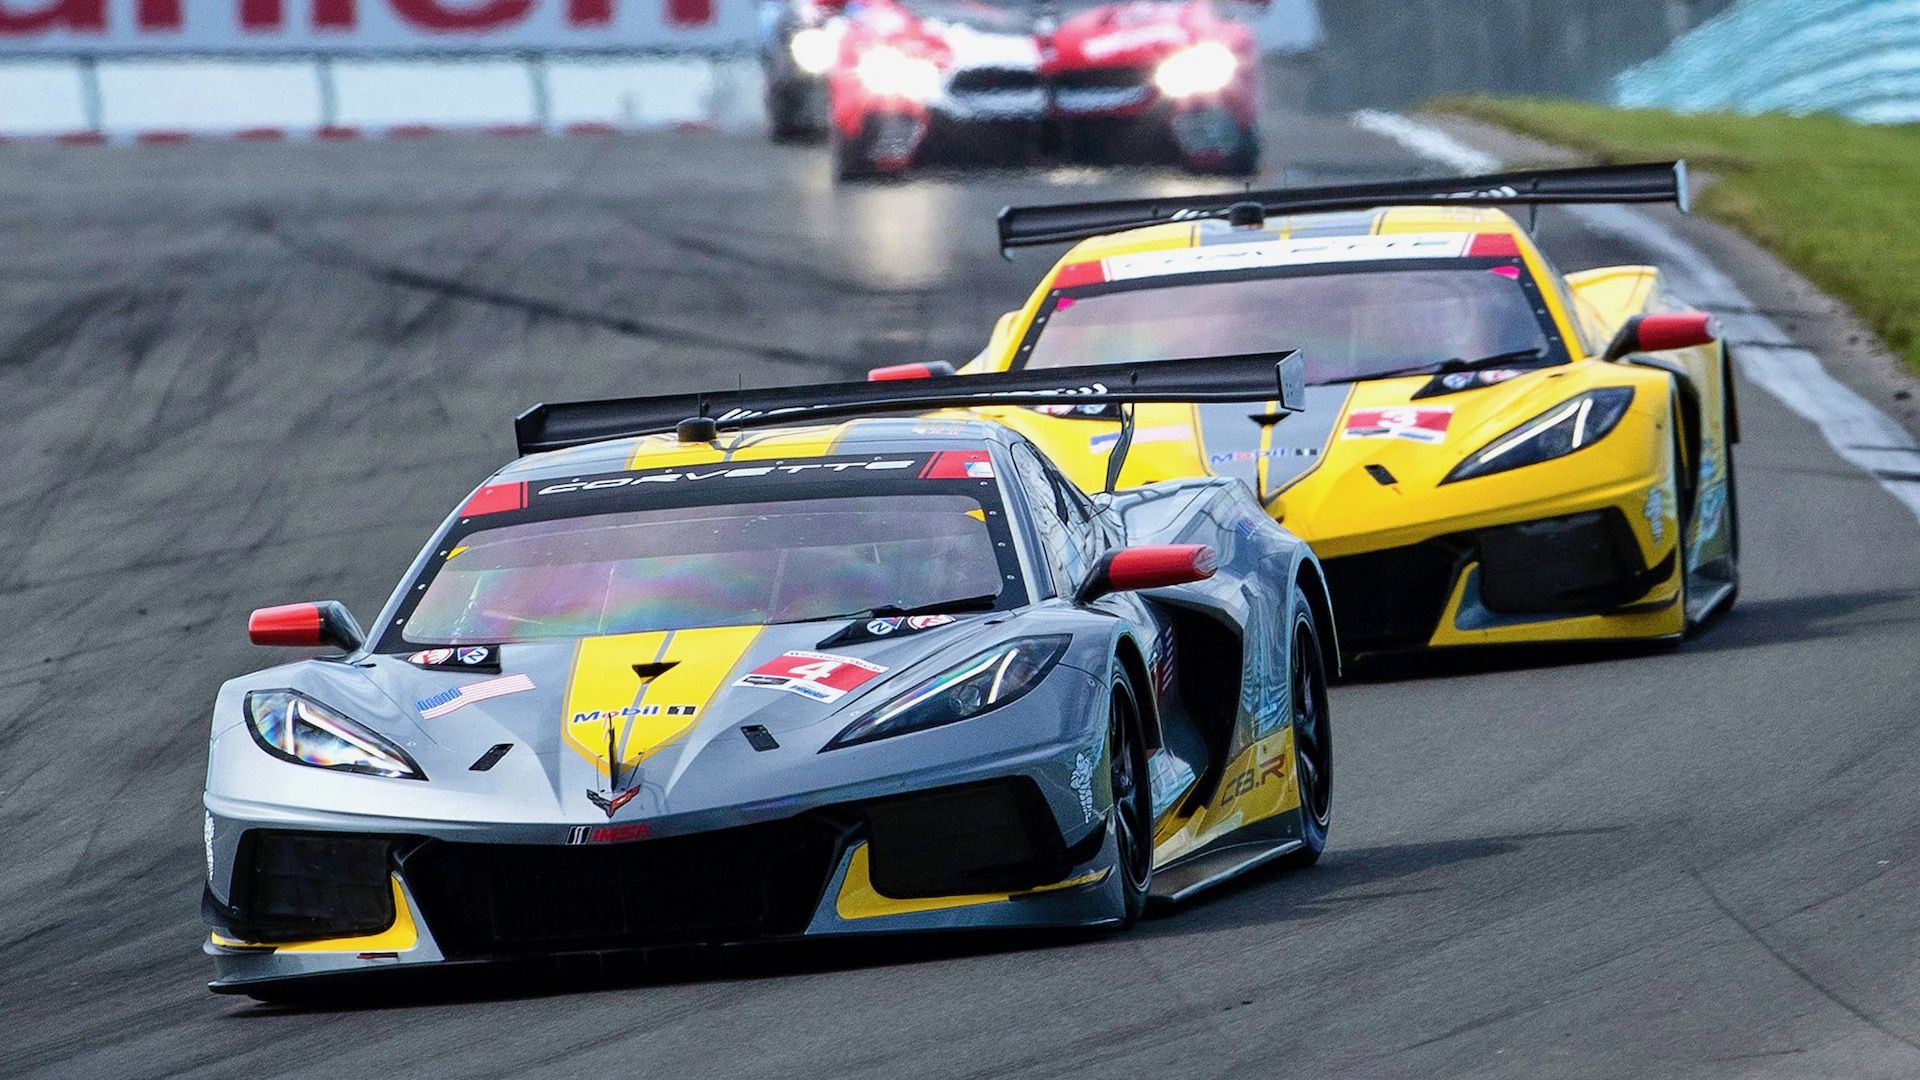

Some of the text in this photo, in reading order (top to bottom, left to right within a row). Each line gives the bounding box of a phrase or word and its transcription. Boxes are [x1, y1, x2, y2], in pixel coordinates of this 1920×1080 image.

[1377, 408, 1417, 430] 3
[538, 460, 915, 496] CORVETTE
[787, 660, 845, 681] 4
[573, 706, 659, 723] Mobil
